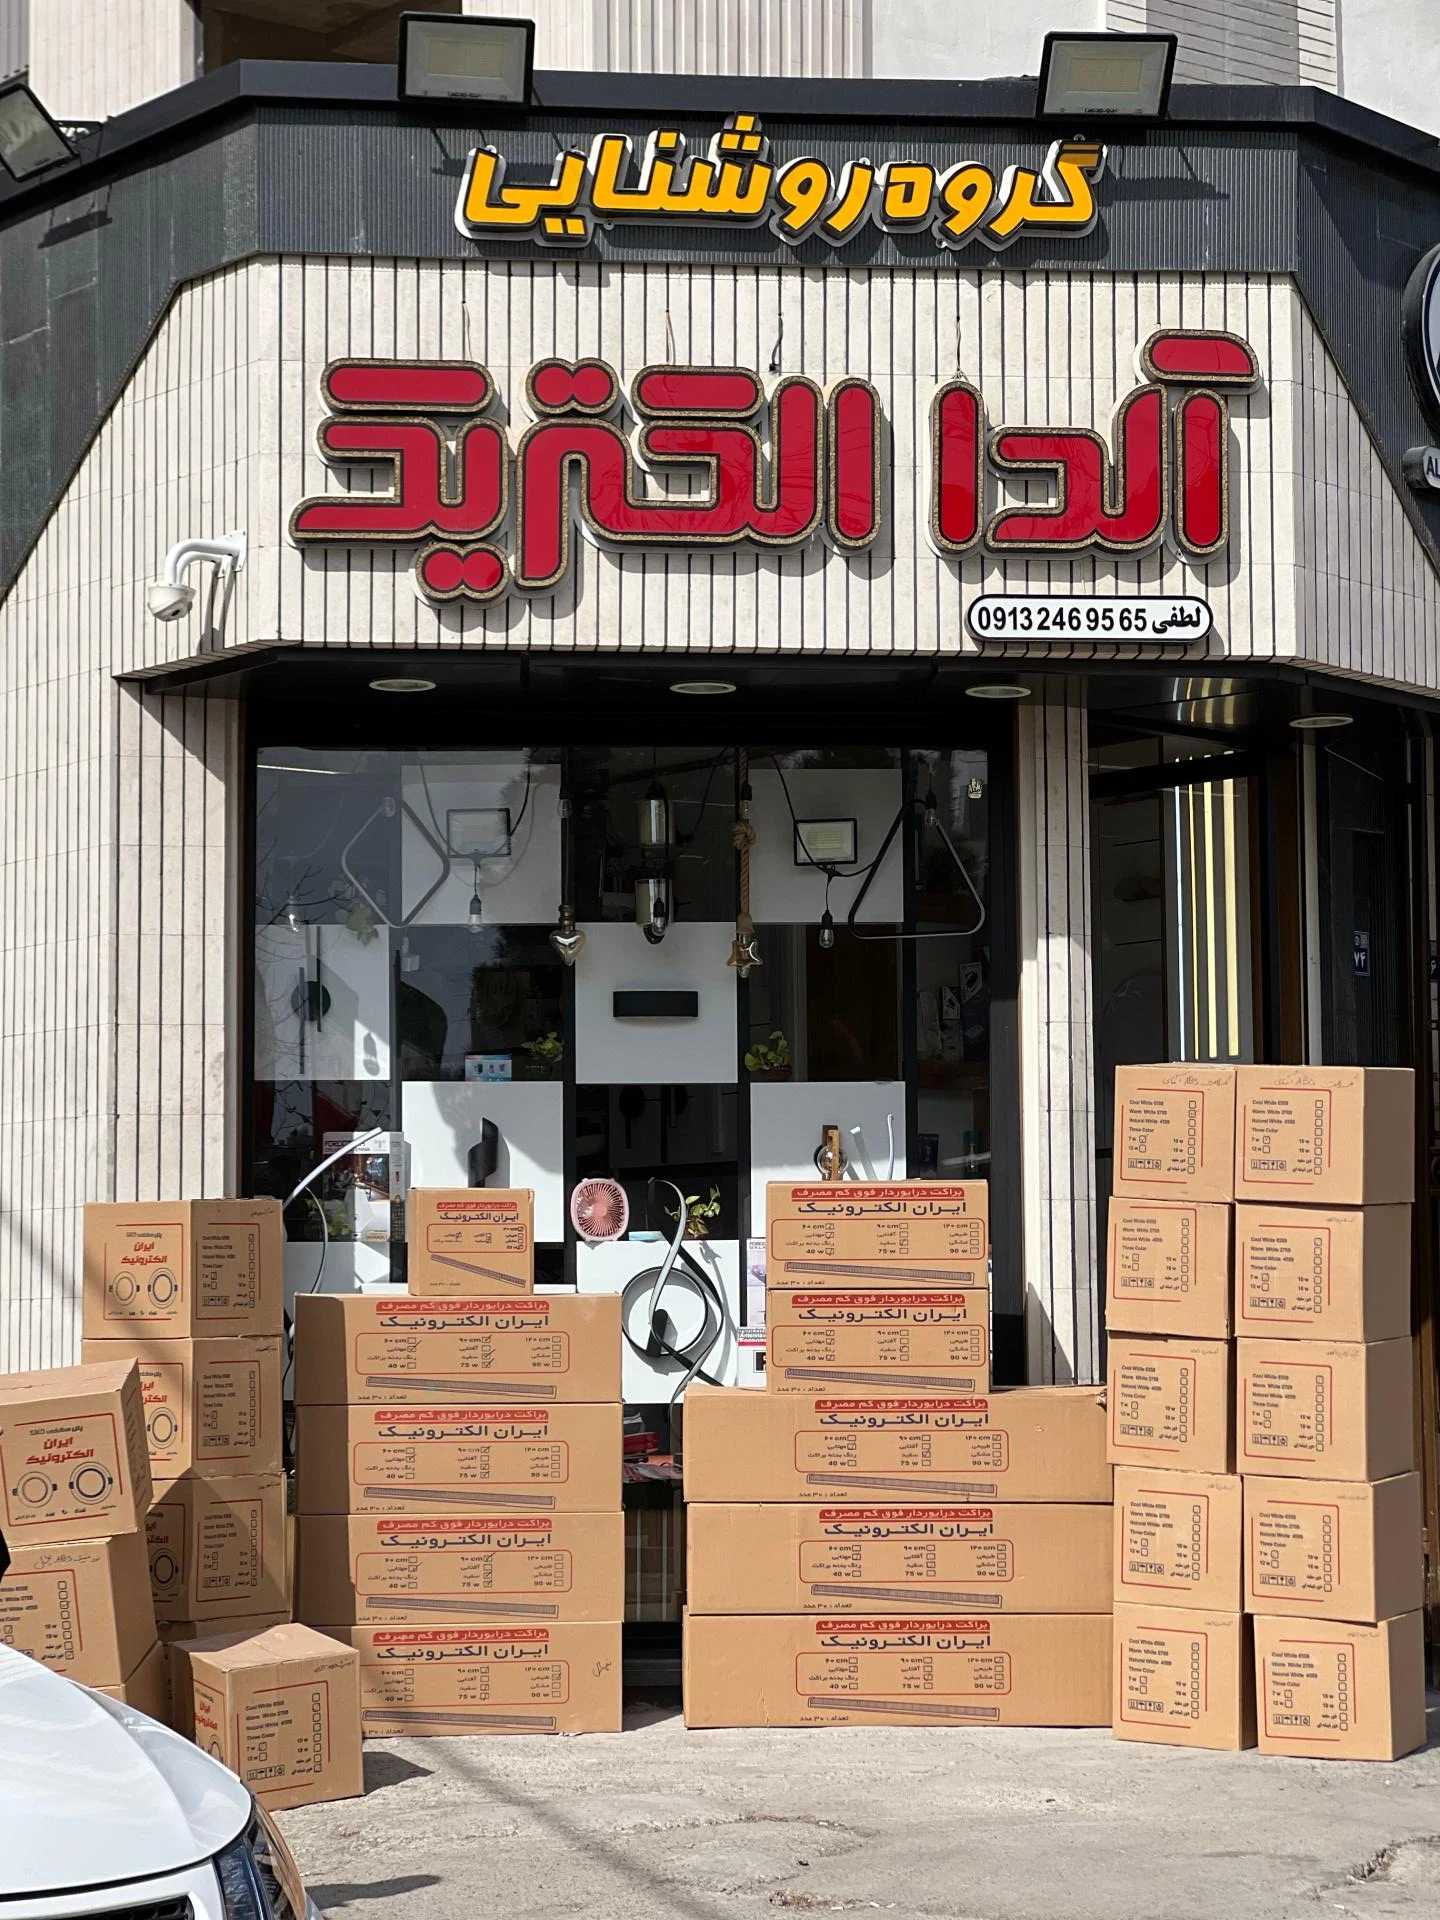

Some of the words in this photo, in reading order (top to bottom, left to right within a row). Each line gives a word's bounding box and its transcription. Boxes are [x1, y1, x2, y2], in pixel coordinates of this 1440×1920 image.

[464, 110, 874, 240] روشنایی
[881, 140, 1108, 243] گروه
[929, 329, 1263, 555] آلدا
[287, 357, 882, 602] الکتریک
[978, 607, 1032, 631] 0913
[1038, 607, 1081, 631] 246
[1086, 608, 1114, 631] 95
[1120, 608, 1146, 631] 65
[1152, 606, 1200, 633] لطفی
[1354, 952, 1366, 968] ۷۴
[798, 1202, 906, 1216] الکترونیک
[913, 1202, 966, 1215] ایران
[799, 1307, 906, 1322] الکترونیک
[913, 1309, 966, 1322] ایران
[380, 1316, 488, 1329] الکترونیک
[495, 1316, 548, 1329] ایران
[820, 1412, 928, 1427] الکترونیک
[935, 1414, 988, 1427] ایران
[379, 1426, 487, 1439] الکترونیک
[494, 1426, 547, 1439] ایران
[44, 1437, 73, 1452] ایران
[26, 1447, 95, 1467] الکترونیک
[825, 1524, 933, 1537] الکترونیک
[940, 1524, 993, 1537] ایران
[381, 1534, 490, 1548] الکترونیک
[497, 1534, 550, 1547] ایران
[821, 1636, 930, 1649] الکترونیک
[937, 1636, 990, 1649] ایران
[376, 1643, 487, 1660] الکترونیک
[494, 1644, 547, 1659] ایران
